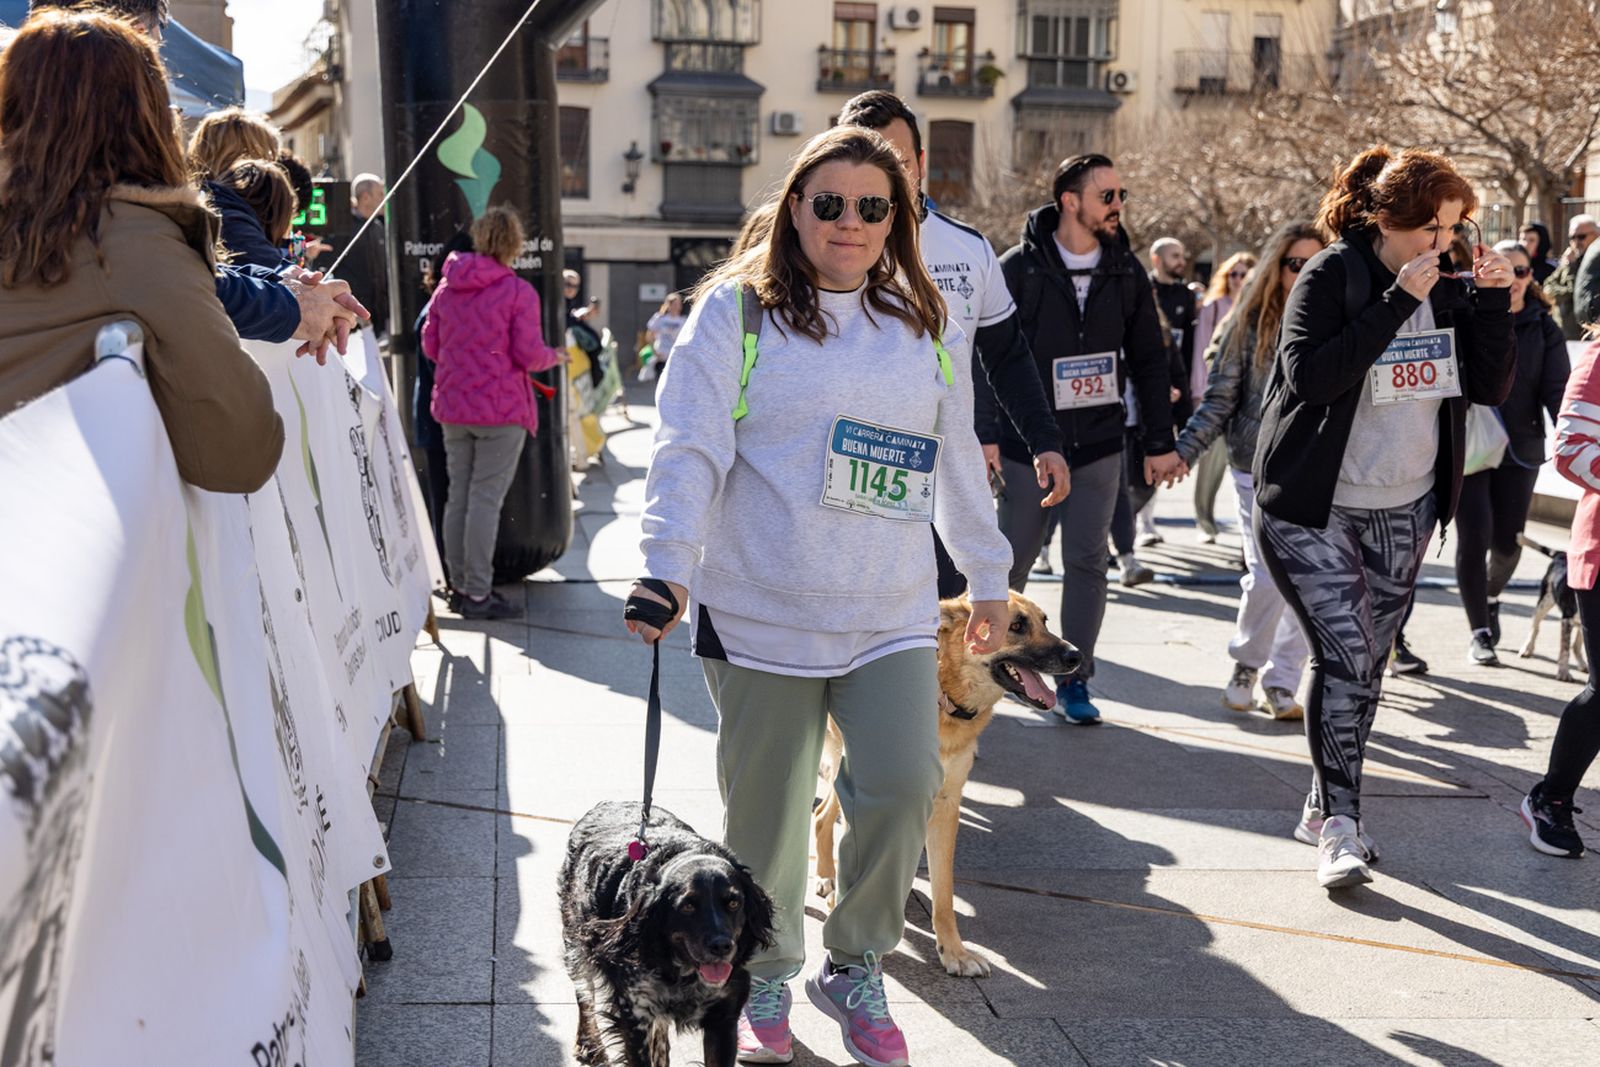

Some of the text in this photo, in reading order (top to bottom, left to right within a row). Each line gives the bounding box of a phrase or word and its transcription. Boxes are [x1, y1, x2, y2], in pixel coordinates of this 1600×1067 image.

[540, 238, 554, 251] de
[927, 263, 971, 273] CAMINATA
[933, 278, 956, 292] RTE
[1392, 361, 1437, 388] 880
[1071, 376, 1104, 396] 952
[846, 425, 926, 450] VI CARRERA CAMINATA
[842, 438, 907, 464] BUENA MUERTE
[849, 458, 909, 502] 1145
